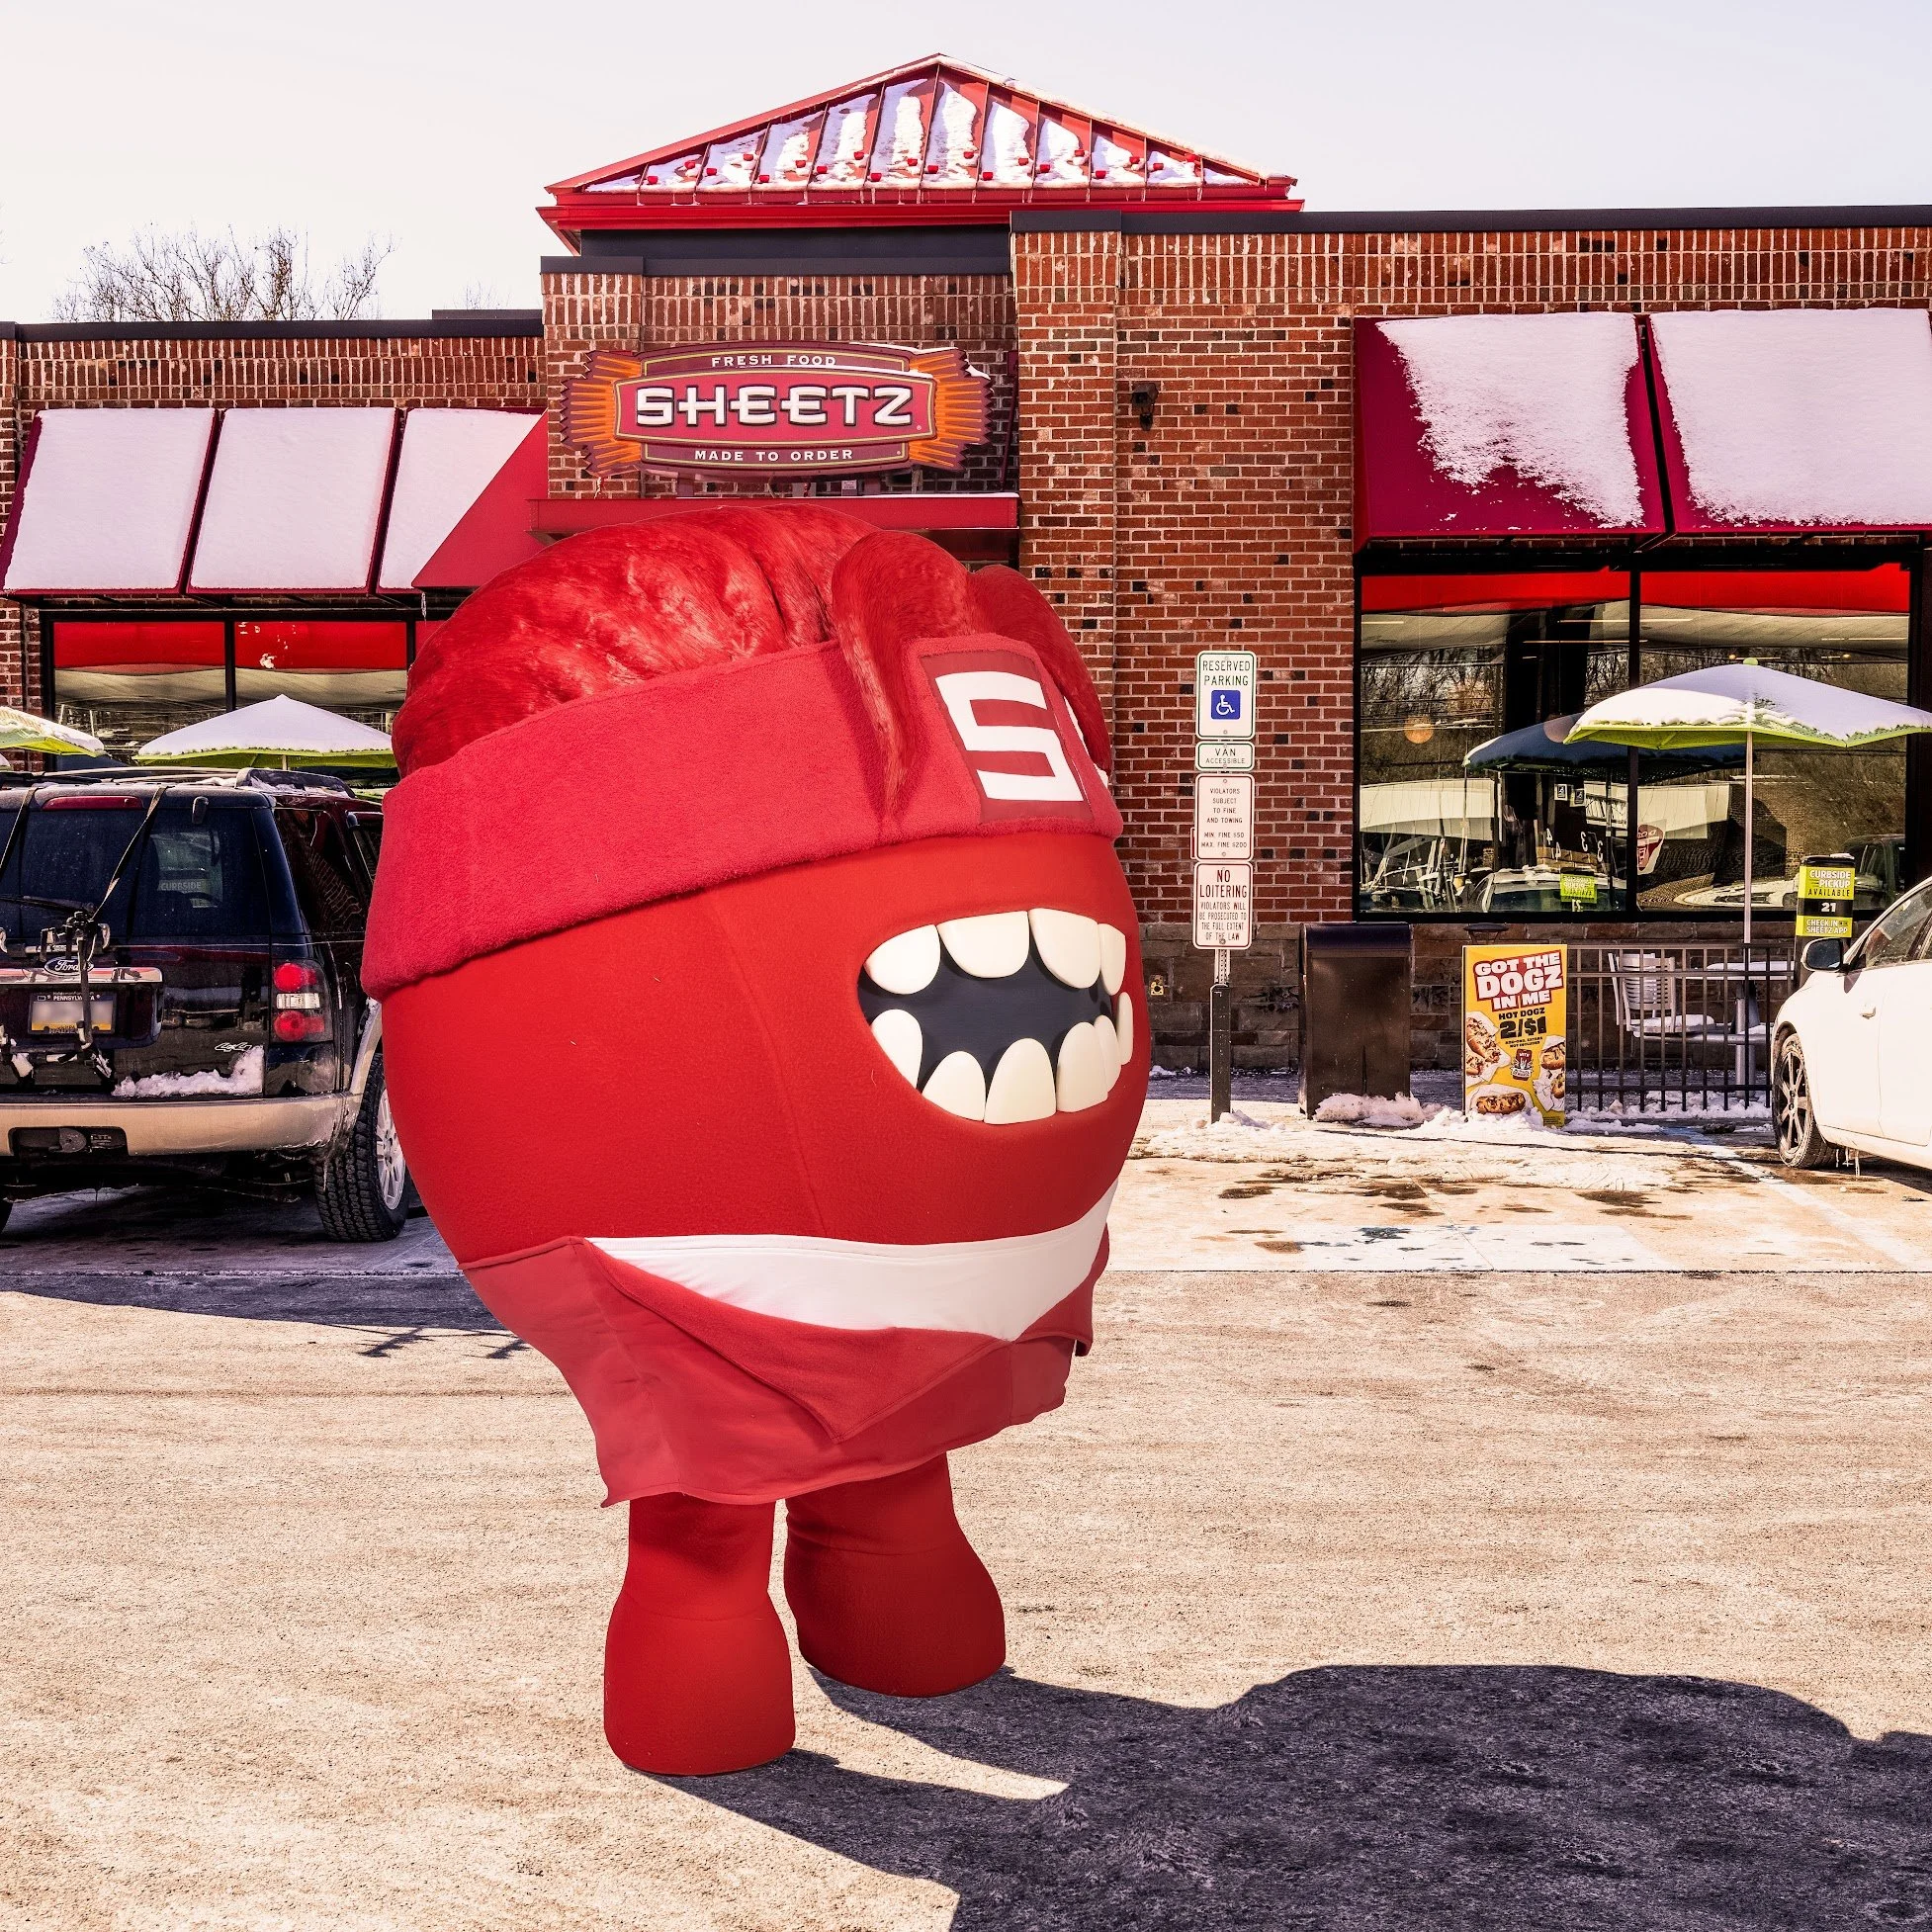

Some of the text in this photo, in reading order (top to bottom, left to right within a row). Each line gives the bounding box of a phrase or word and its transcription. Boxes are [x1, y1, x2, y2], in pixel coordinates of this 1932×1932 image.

[711, 354, 837, 367] FRESH FOOD
[635, 384, 913, 428] SHEETZ
[694, 449, 853, 462] MADE TO ORDER
[1202, 660, 1251, 671] RESERVED
[1203, 675, 1249, 686] PARKING
[934, 670, 1084, 802] S
[1214, 747, 1236, 756] VAN
[1216, 869, 1231, 883] NO
[1809, 869, 1851, 879] CURBSIDE
[161, 882, 202, 891] CURBSIDE
[1818, 879, 1851, 888] PICKUP
[1199, 884, 1248, 899] LOITERING
[1808, 888, 1850, 897] AVAILABLE
[1200, 901, 1246, 911] VIOLATORS WILL
[1820, 902, 1837, 913] 21
[1198, 912, 1247, 921] BE PROSECUTED TO
[1201, 922, 1244, 930] THE FULL EXTENT
[1205, 931, 1240, 941] OF THE LAW
[1474, 951, 1560, 977] GOT THE
[1476, 965, 1563, 1000] DOGZ
[1492, 990, 1551, 1010] IN ME
[1498, 1007, 1545, 1020] HOT DOGZ
[1499, 1015, 1547, 1039] 2/$1
